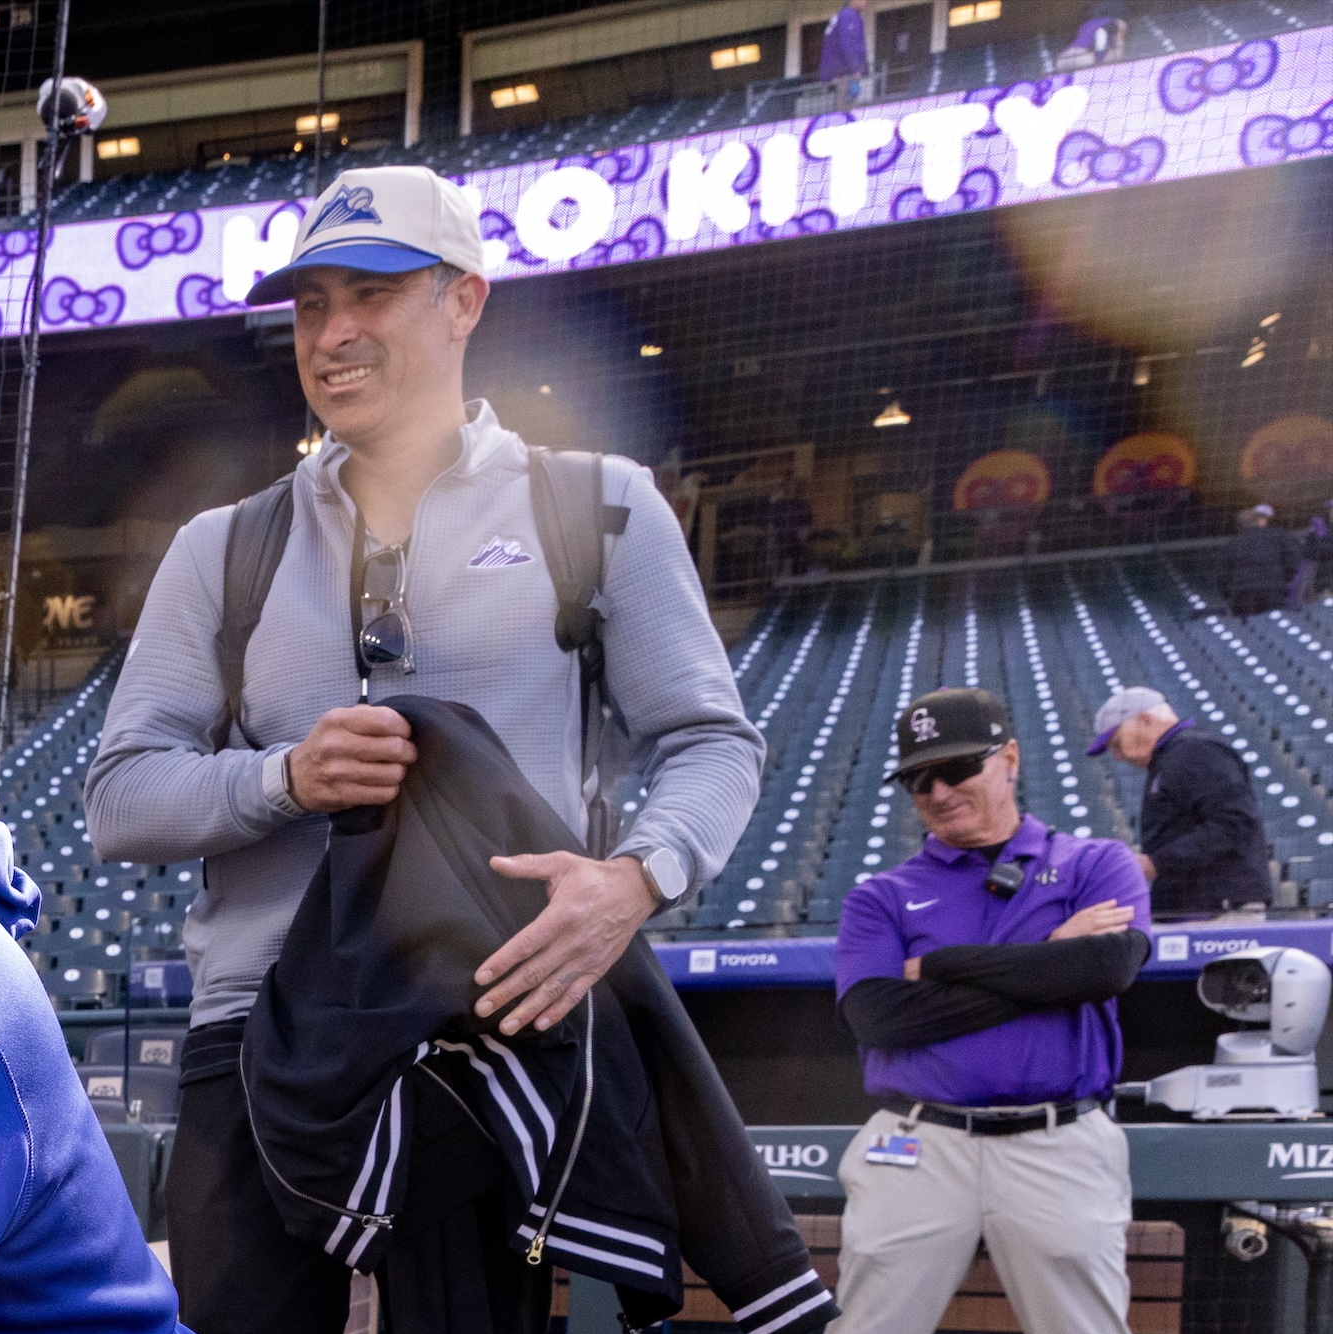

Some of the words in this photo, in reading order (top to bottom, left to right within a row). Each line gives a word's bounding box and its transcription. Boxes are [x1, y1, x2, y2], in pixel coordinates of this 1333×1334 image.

[667, 85, 1089, 240] KITTY
[1192, 939, 1261, 954] TOYOTA
[719, 953, 779, 967] TOYOTA
[754, 1144, 829, 1168] UHO
[1267, 1142, 1333, 1169] MIZ
